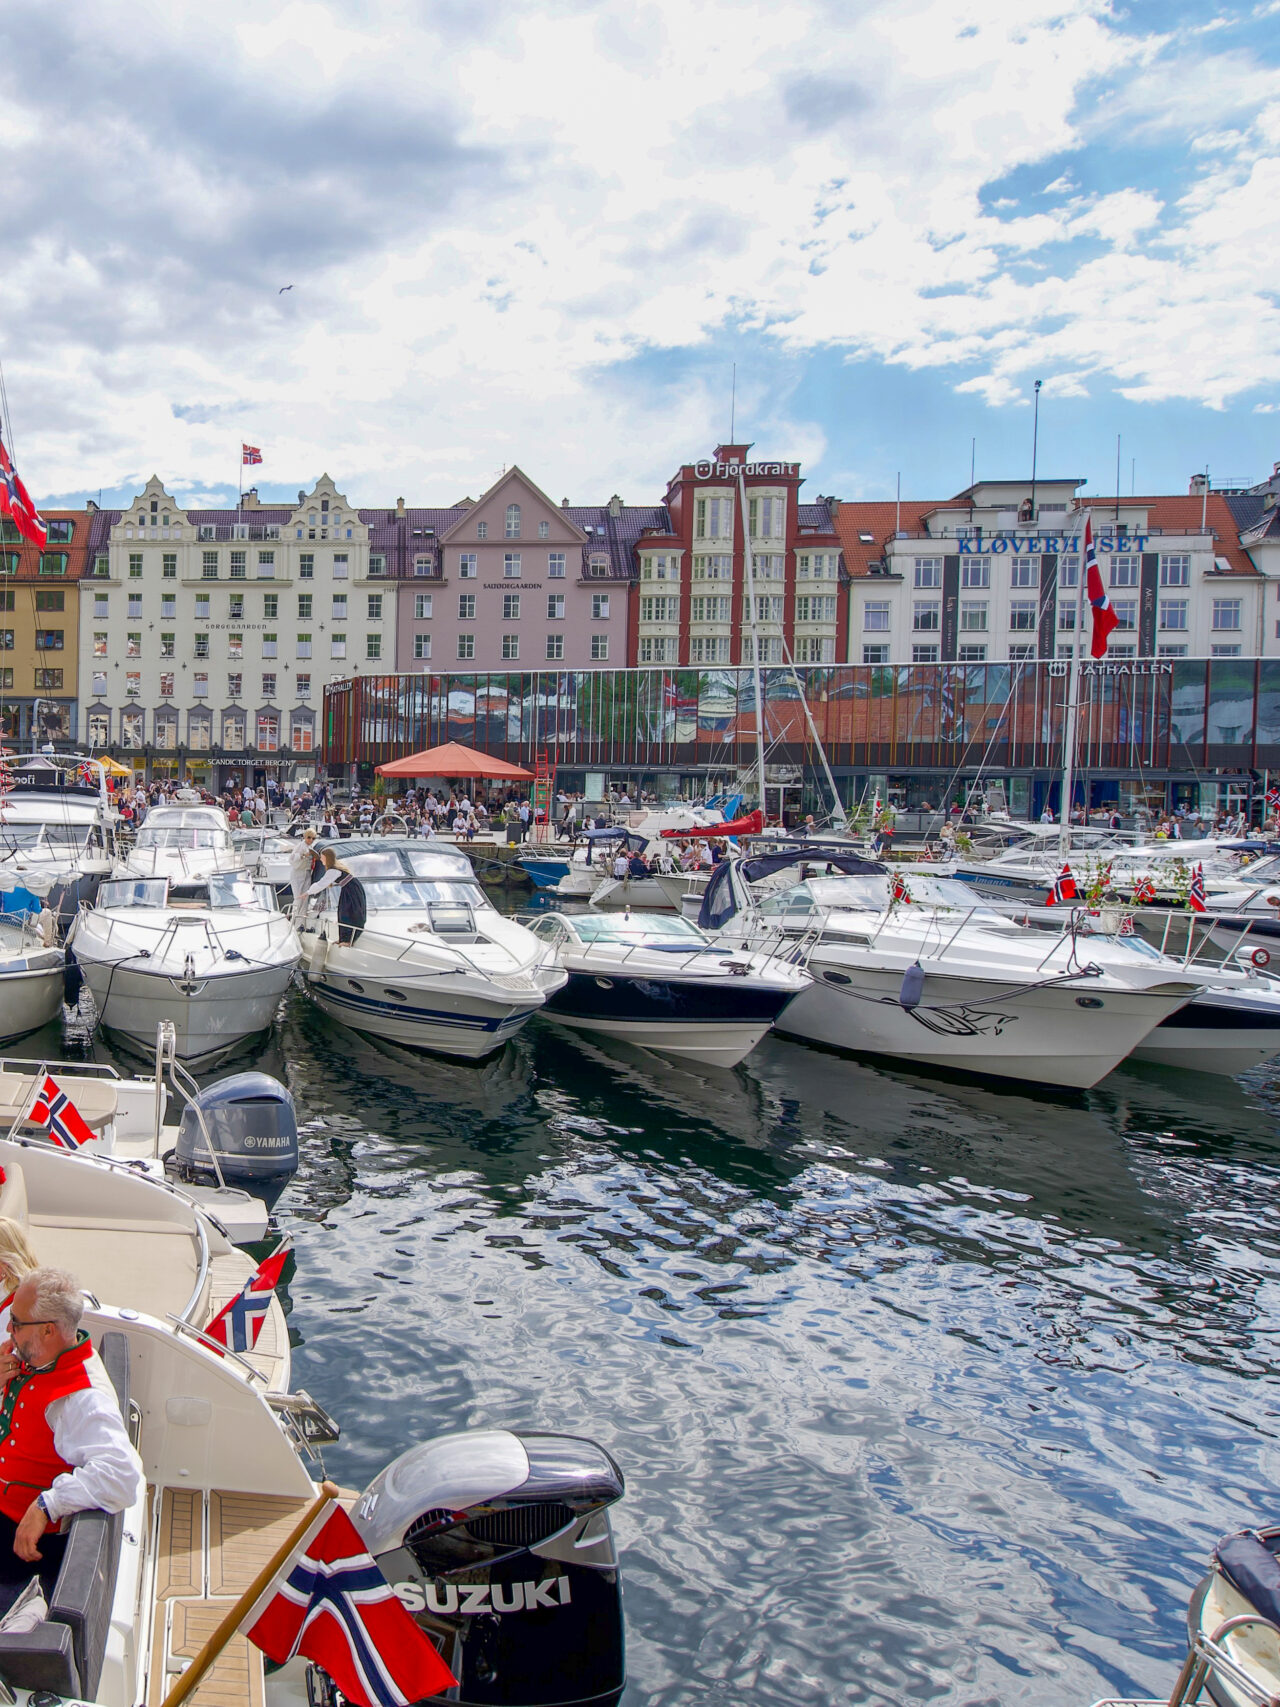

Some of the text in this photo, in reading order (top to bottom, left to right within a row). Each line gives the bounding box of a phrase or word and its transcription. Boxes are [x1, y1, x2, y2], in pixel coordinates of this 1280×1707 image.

[716, 462, 794, 479] Fjordkraft
[957, 536, 1150, 554] KLØVERHSET
[238, 759, 264, 767] TORGET
[265, 759, 291, 767] BERGEN
[256, 1136, 291, 1148] YAMAHA
[392, 1575, 572, 1614] SUZUKI
